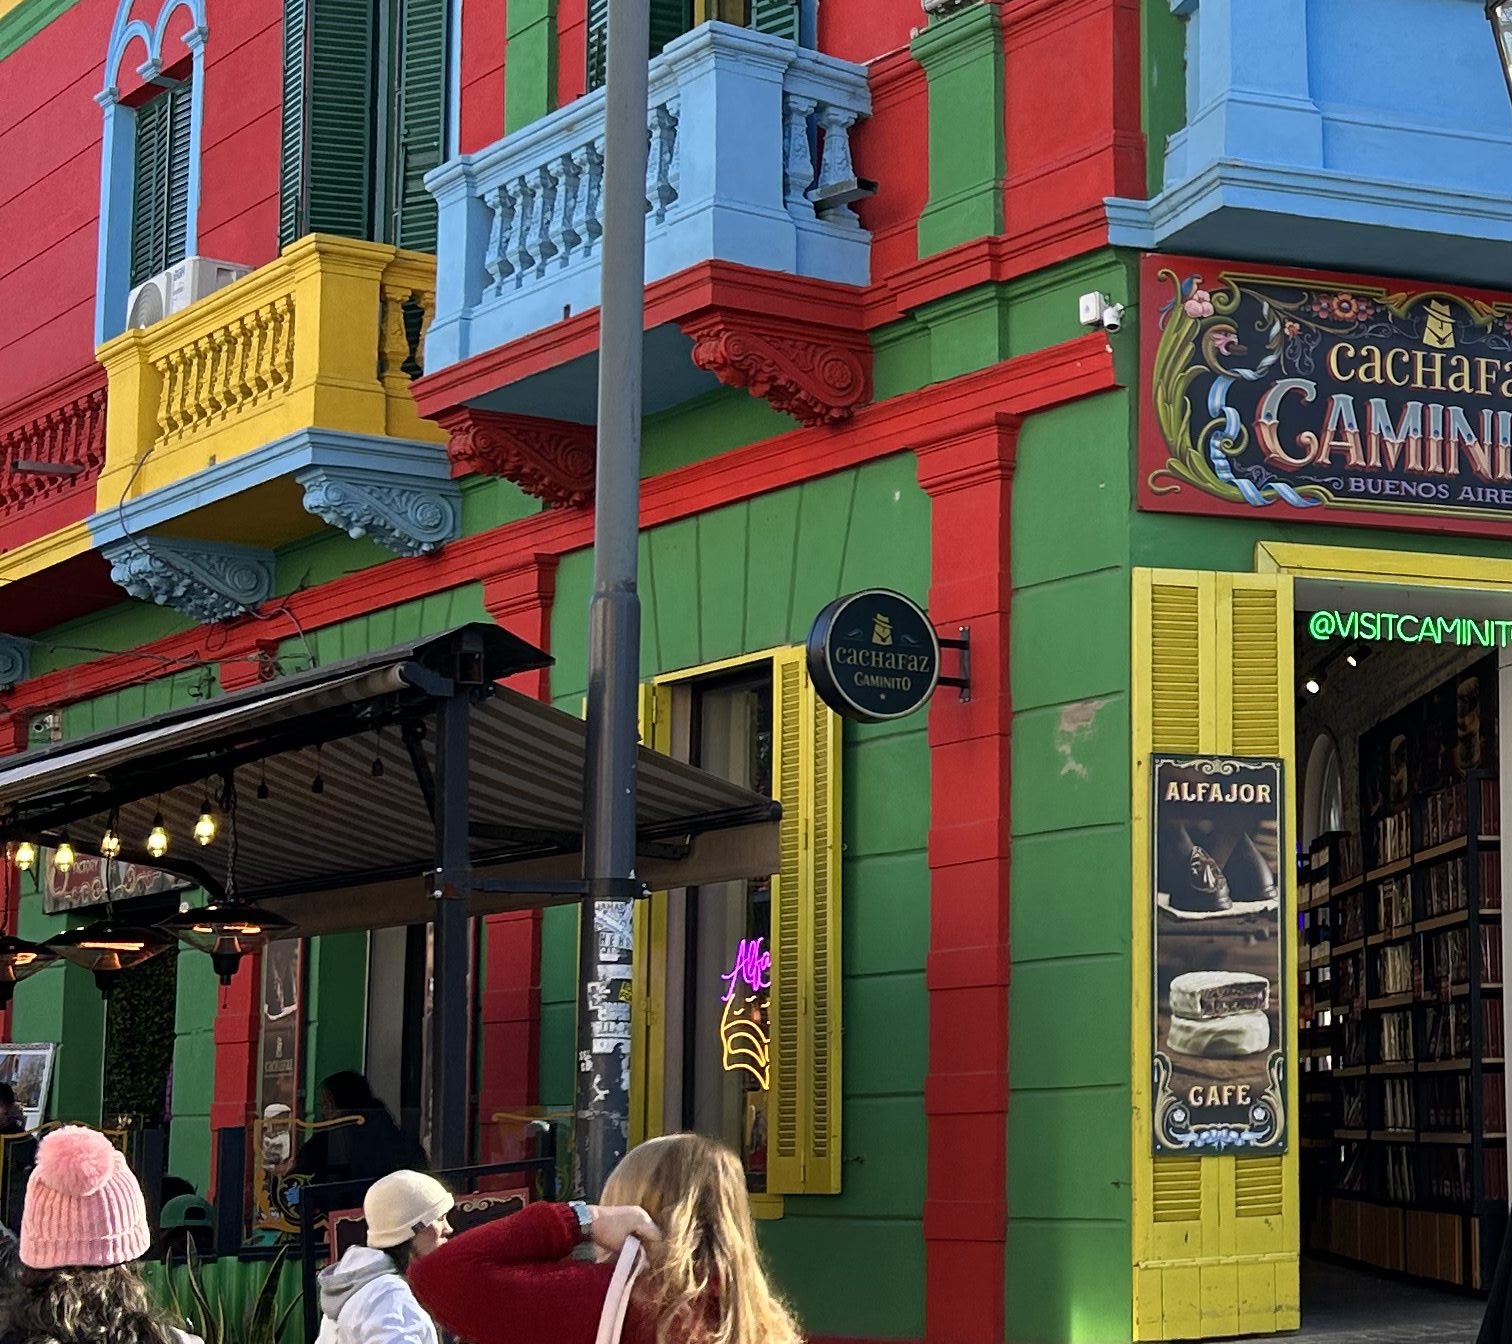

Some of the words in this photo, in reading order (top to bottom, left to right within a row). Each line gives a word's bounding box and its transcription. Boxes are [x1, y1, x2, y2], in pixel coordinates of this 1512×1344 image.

[1348, 477, 1450, 500] BUENOS
[853, 671, 912, 692] CAMINITO
[1165, 782, 1273, 804] ALFAJOR
[1188, 1084, 1253, 1108] CAFE
